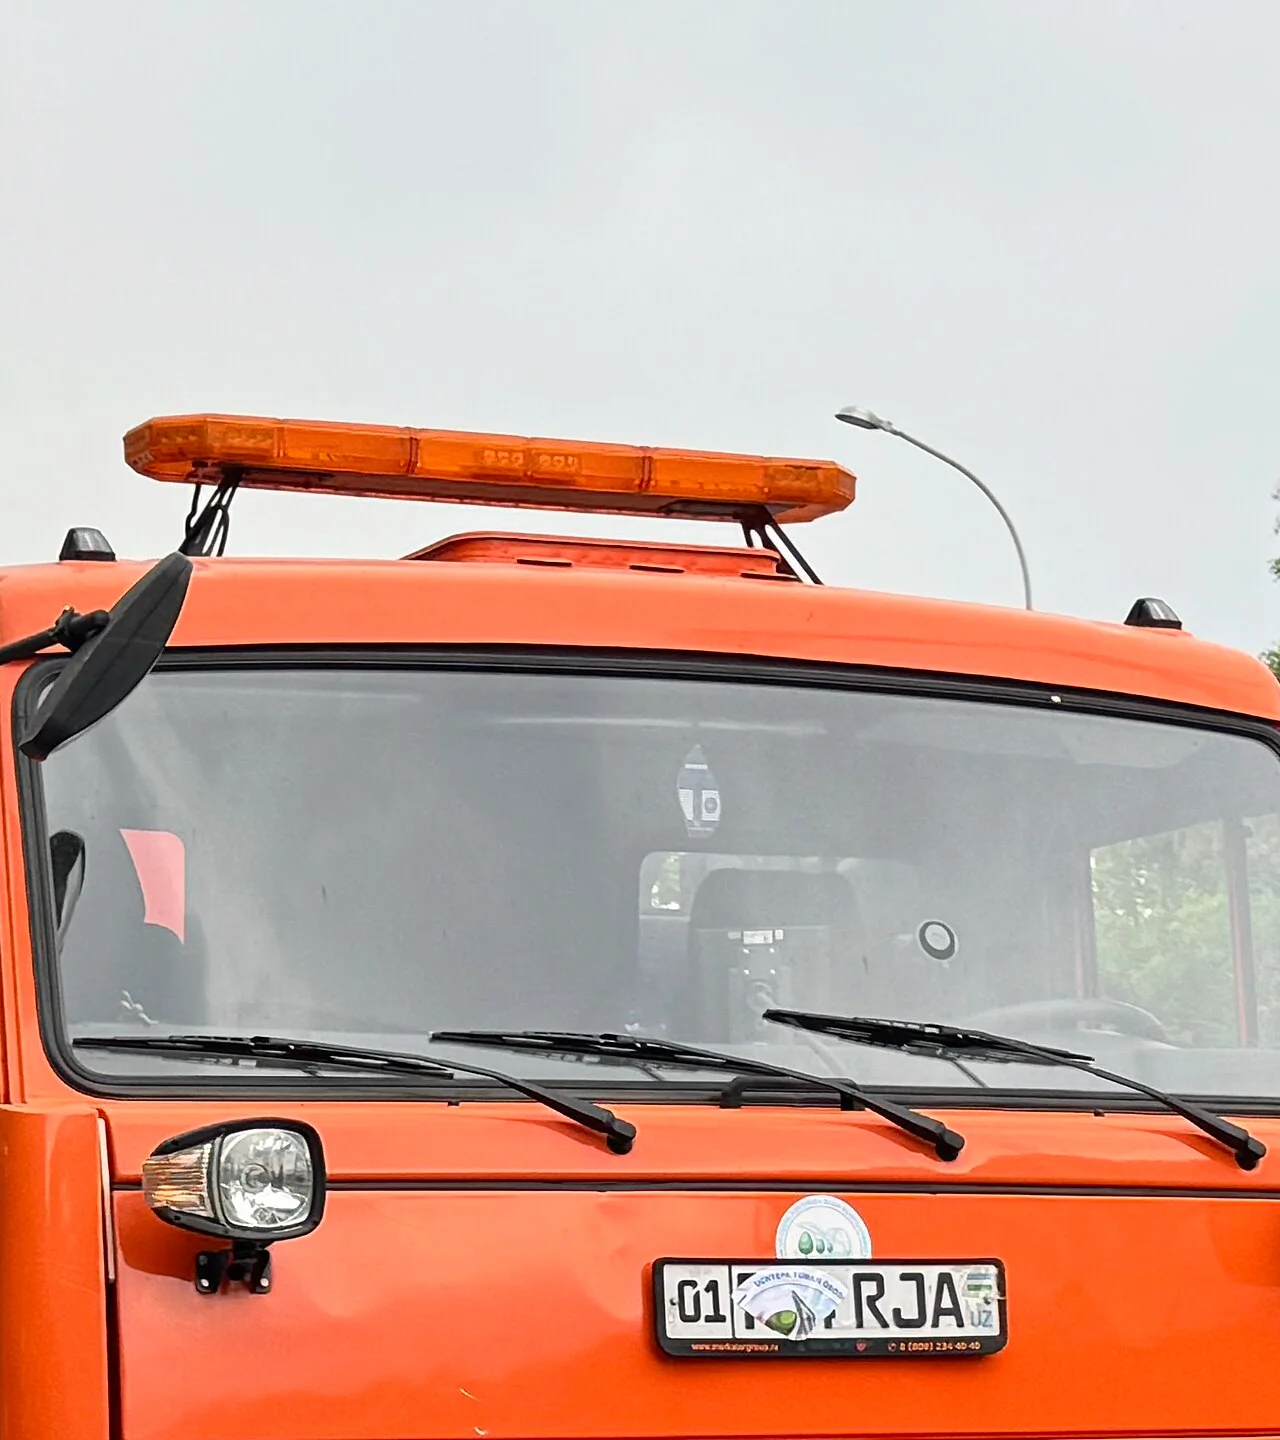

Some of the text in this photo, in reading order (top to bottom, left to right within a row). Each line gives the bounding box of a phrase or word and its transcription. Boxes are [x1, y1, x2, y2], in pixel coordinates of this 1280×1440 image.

[677, 1279, 726, 1323] 01
[853, 1272, 964, 1328] RJA
[970, 1310, 993, 1328] UZ
